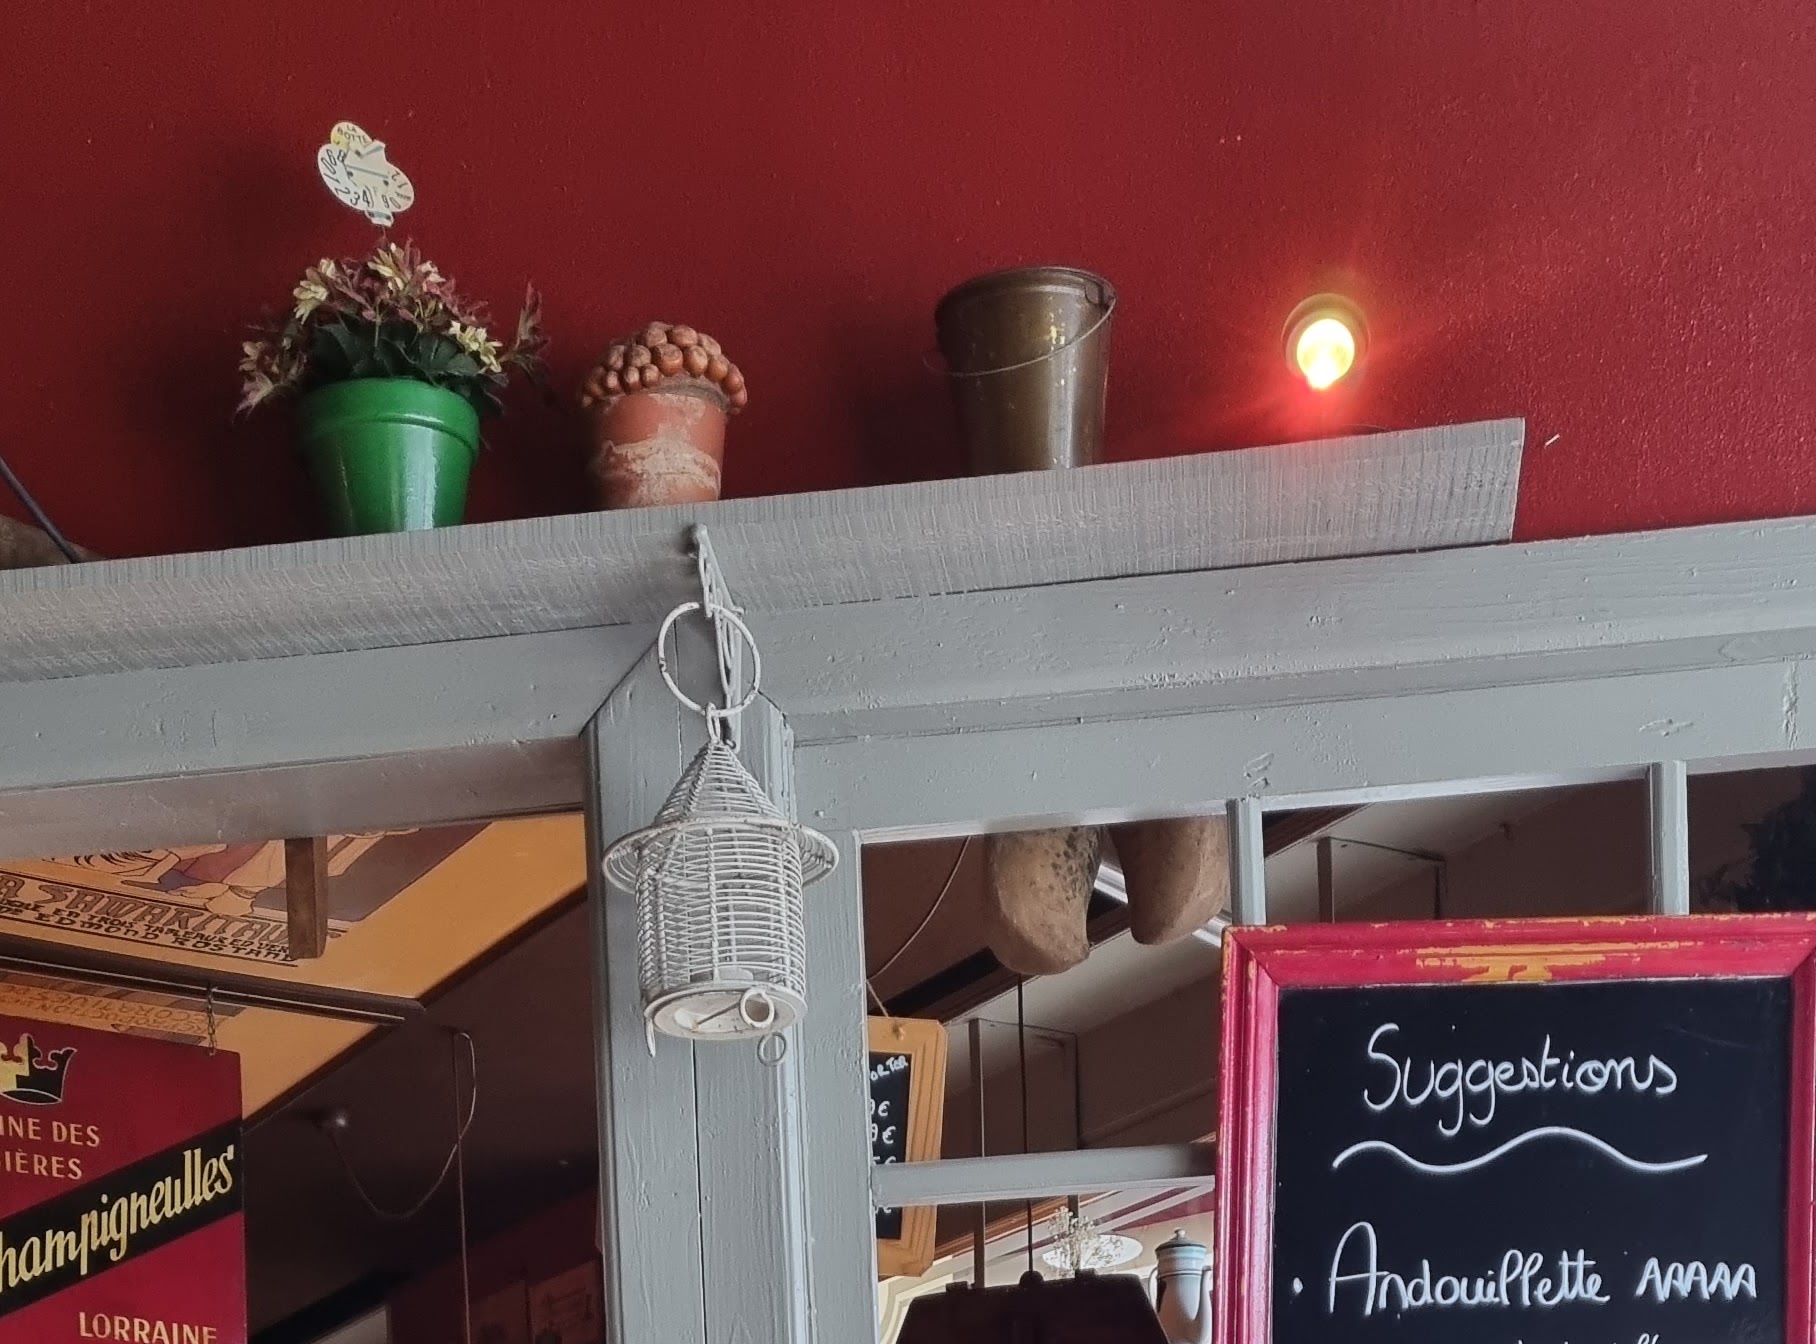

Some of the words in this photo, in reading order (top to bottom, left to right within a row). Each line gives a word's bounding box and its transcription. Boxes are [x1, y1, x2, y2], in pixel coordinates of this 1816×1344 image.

[0, 875, 25, 900] A
[35, 912, 160, 940] EDMOND
[1363, 1021, 1678, 1137] Suggestions
[0, 1115, 41, 1140] INE
[52, 1121, 100, 1147] DES
[4, 1149, 83, 1180] IÈRES
[0, 1144, 235, 1294] hampigneulles
[1328, 1220, 1611, 1316] Andouillette
[1635, 1256, 1758, 1301] AAAAA
